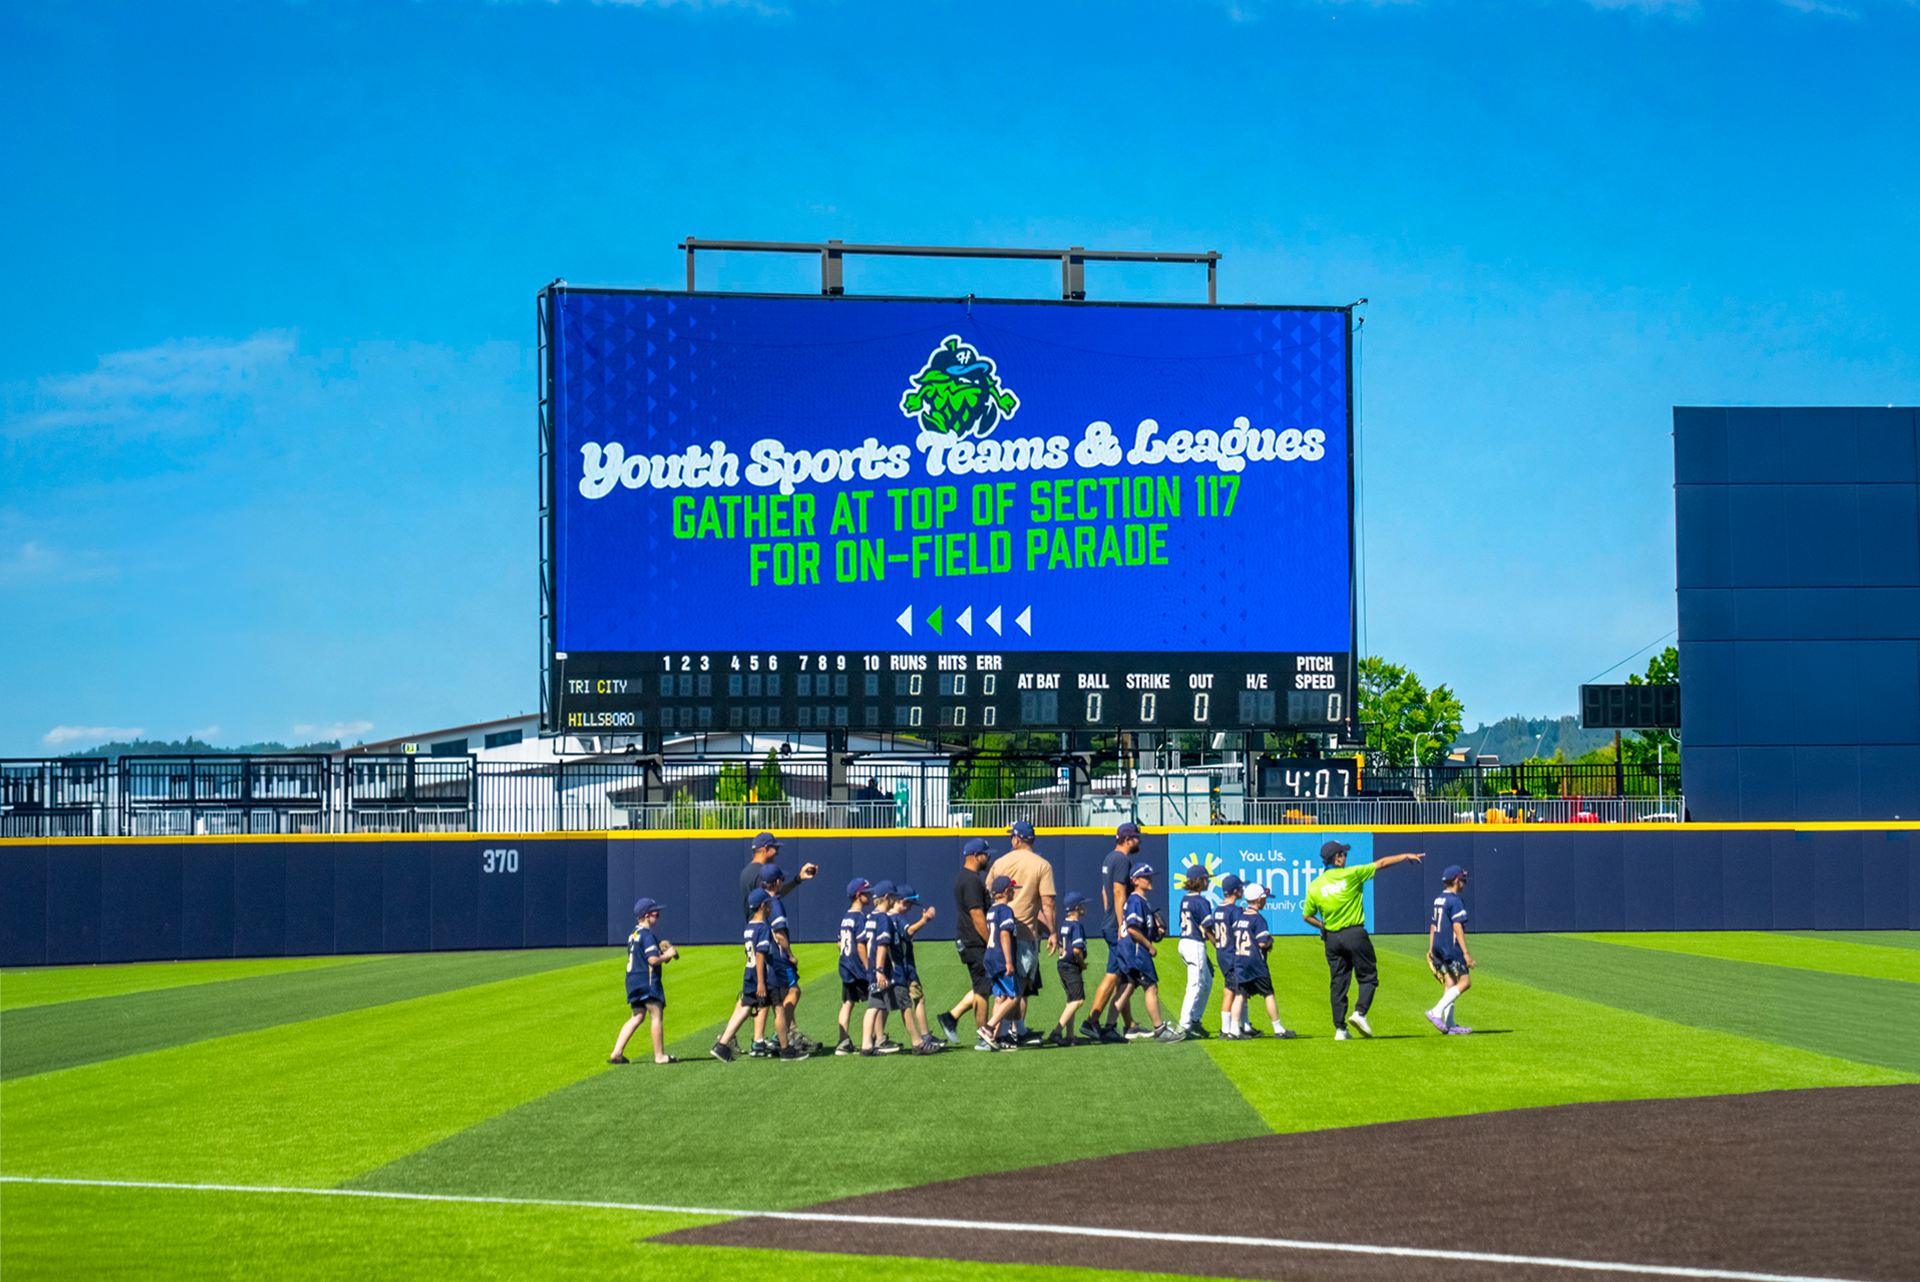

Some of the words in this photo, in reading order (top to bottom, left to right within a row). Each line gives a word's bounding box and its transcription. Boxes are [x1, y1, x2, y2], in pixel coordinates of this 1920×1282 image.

[579, 441, 740, 499] Youth
[745, 438, 911, 495] Sports
[916, 428, 1070, 476] Teams
[1074, 421, 1123, 467] &
[1127, 416, 1326, 472] Leagues
[673, 493, 815, 539] GATHER
[830, 490, 875, 535] AT
[887, 485, 957, 533] TOP
[972, 482, 1017, 526] OF
[1030, 475, 1181, 523] SECTION
[1195, 475, 1241, 517] 117
[750, 542, 820, 587] FOR
[836, 531, 1012, 583] ON-FIELD
[1027, 523, 1169, 571] PARADE
[663, 655, 670, 671] 1
[681, 655, 691, 671] 2
[700, 655, 710, 671] 3
[730, 655, 740, 671] 4
[749, 655, 759, 671] 5
[768, 655, 778, 671] 6
[799, 655, 808, 671] 7
[818, 655, 827, 671] 8
[836, 655, 846, 671] 9
[863, 655, 880, 671] 10
[890, 654, 927, 671] RUNS
[938, 655, 967, 671] HITS
[976, 655, 1002, 671] ERR
[1296, 656, 1334, 672] PITCH
[568, 679, 590, 694] TRI
[597, 679, 628, 694] CITY
[910, 675, 922, 695] 0
[954, 674, 966, 695] 0
[984, 674, 996, 695] 0
[1017, 673, 1034, 689] AT
[1036, 673, 1061, 689] BAT
[1078, 673, 1110, 689] BALL
[1126, 673, 1171, 689] STRIKE
[1189, 673, 1214, 689] OUT
[1246, 673, 1268, 690] H/E
[1295, 673, 1336, 690] SPEED
[910, 706, 922, 726] 0
[954, 706, 966, 726] 0
[984, 706, 996, 726] 0
[1087, 693, 1101, 722] 0
[1141, 693, 1156, 722] 0
[1194, 693, 1209, 722] 0
[1328, 693, 1342, 722] 0
[568, 712, 635, 727] HILLSBORO
[1285, 768, 1350, 798] 4:07
[483, 850, 519, 873] 370
[1239, 849, 1265, 862] You.
[1268, 849, 1287, 862] Us.
[1239, 859, 1325, 896] unit
[1319, 878, 1348, 898] STAFF
[1234, 930, 1251, 956] 12
